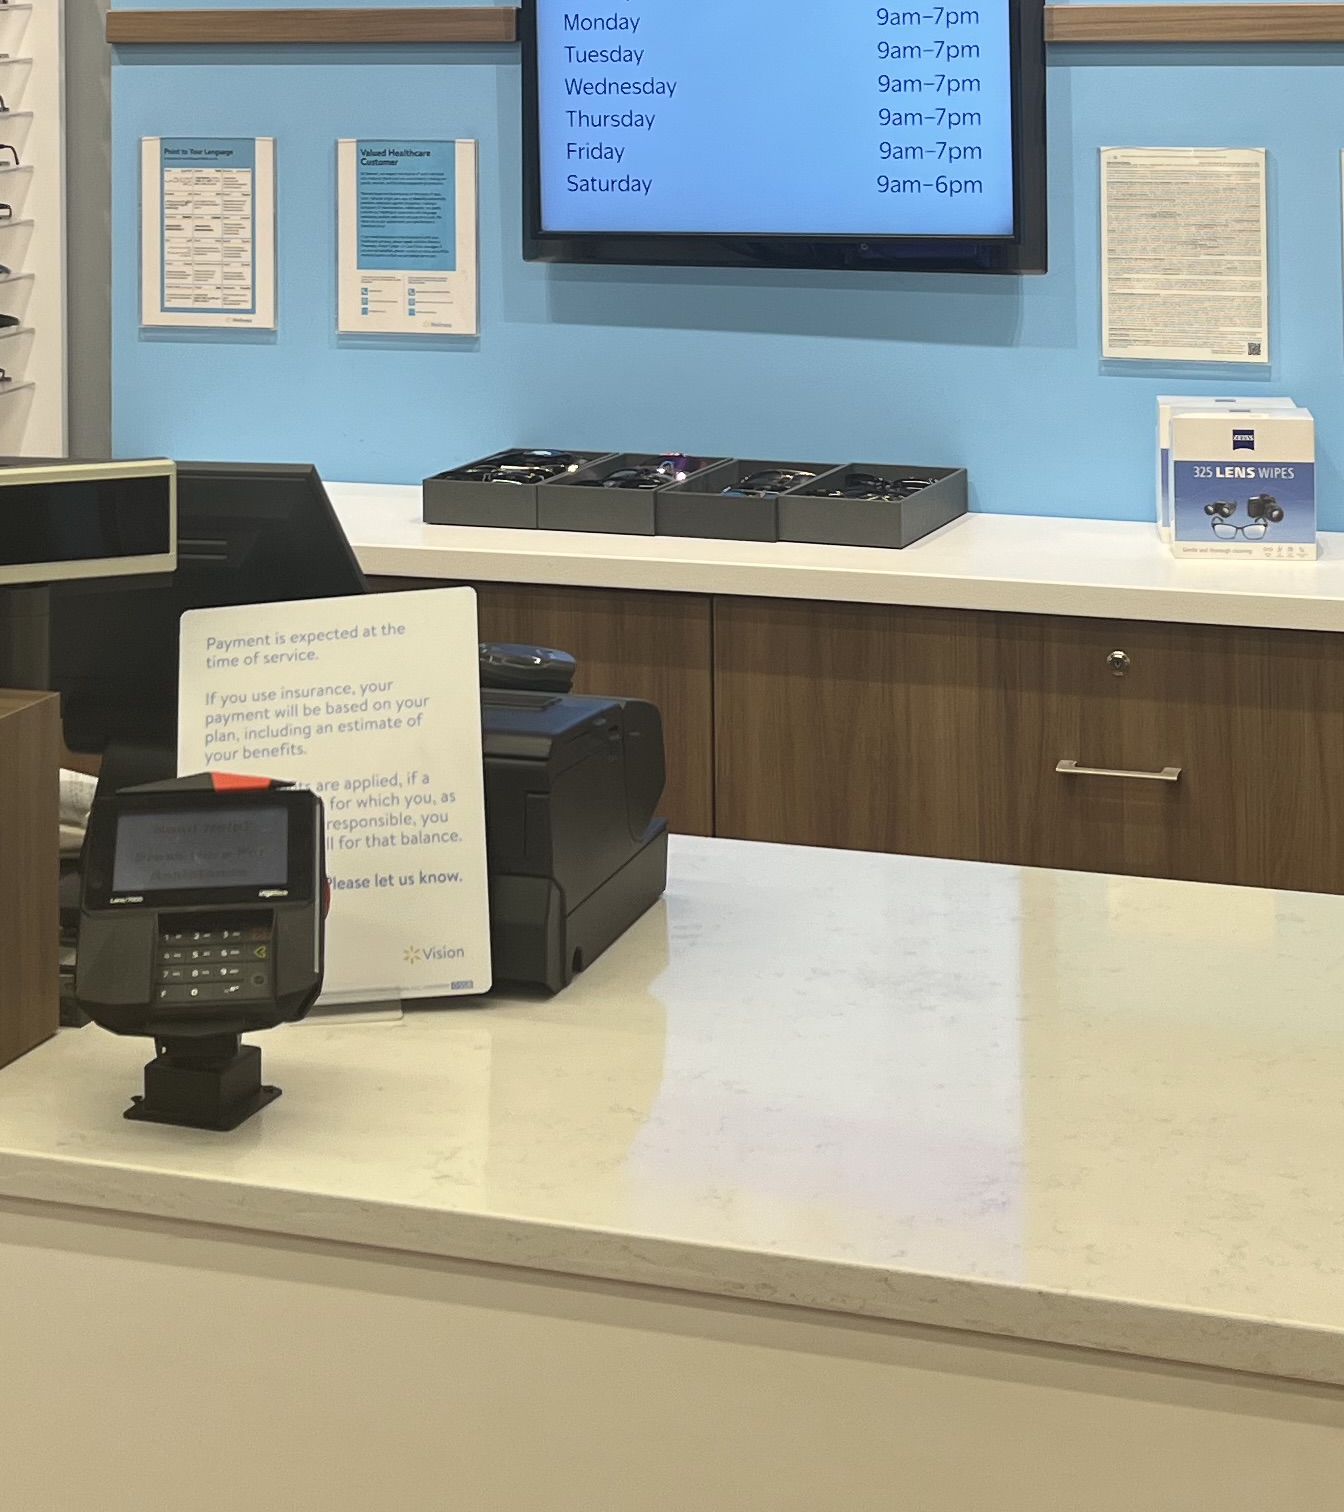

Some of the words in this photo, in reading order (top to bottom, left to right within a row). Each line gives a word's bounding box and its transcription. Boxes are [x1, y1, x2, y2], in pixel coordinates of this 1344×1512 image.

[564, 13, 640, 34] Monday
[564, 45, 644, 66] Tuesday
[565, 77, 677, 98] Wednesday
[566, 110, 656, 130] Thursday
[360, 158, 398, 166] Customer
[567, 142, 625, 163] Friday
[567, 174, 652, 196] Saturday
[1193, 466, 1213, 478] 325
[1216, 467, 1256, 478] LENS
[1258, 468, 1294, 478] WIPES
[207, 635, 271, 652] Payment
[276, 632, 285, 645] is
[290, 625, 358, 645] expected
[363, 625, 377, 637] at
[381, 623, 405, 636] the
[207, 655, 239, 669] time
[244, 652, 260, 666] of
[264, 649, 319, 664] service.
[375, 873, 394, 887] let
[400, 874, 414, 886] us
[419, 870, 463, 885] know.
[422, 945, 464, 960] Vision
